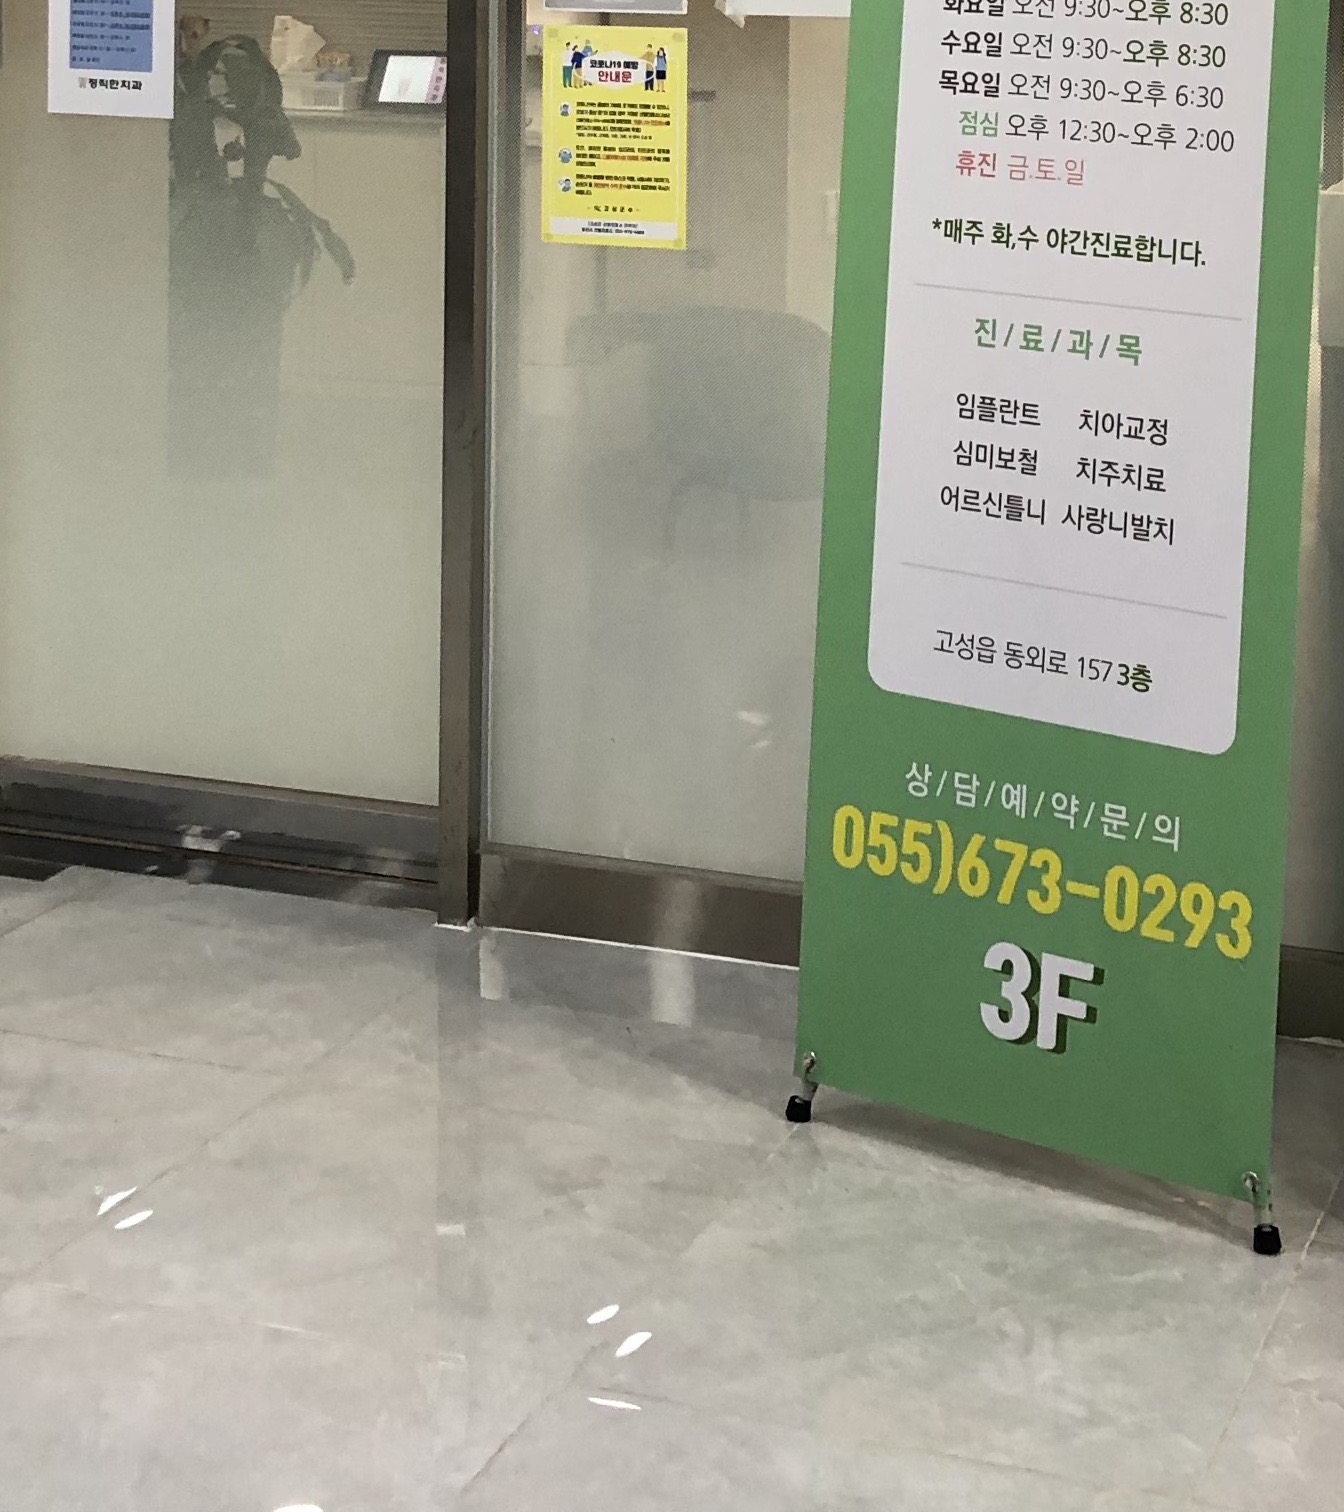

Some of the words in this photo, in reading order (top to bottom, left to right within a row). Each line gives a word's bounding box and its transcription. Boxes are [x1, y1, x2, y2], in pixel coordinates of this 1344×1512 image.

[941, 30, 1003, 57] 수요일
[1177, 44, 1226, 67] 8:30
[88, 78, 142, 90] 정직한치과
[938, 70, 1000, 98] 목요일
[1008, 73, 1051, 100] 오전
[1175, 84, 1224, 109] 6:30
[958, 110, 999, 137] 점심
[1005, 114, 1049, 140] 오후
[1185, 127, 1234, 152] 2:00
[956, 150, 996, 177] 휴진
[991, 222, 1039, 250] 화,수
[1047, 228, 1206, 267] 야간진료합니다.
[974, 318, 1142, 366] 진/료/과/목
[956, 393, 1041, 426] 임플란트
[1078, 409, 1168, 446] 치아교정
[953, 441, 1038, 476] 심미보철
[1076, 457, 1166, 492] 치주치료
[940, 486, 1046, 525] 어르신틀니
[1061, 505, 1175, 545] 사랑니발치
[933, 630, 997, 664] 고성읍
[1004, 642, 1068, 676] 동외로
[1077, 656, 1113, 682] 157
[1117, 663, 1153, 692] 3층
[905, 762, 1181, 853] 상/담/예/약/문/의
[832, 805, 1253, 959] 055)673-0293
[980, 941, 1101, 1053] 3F
